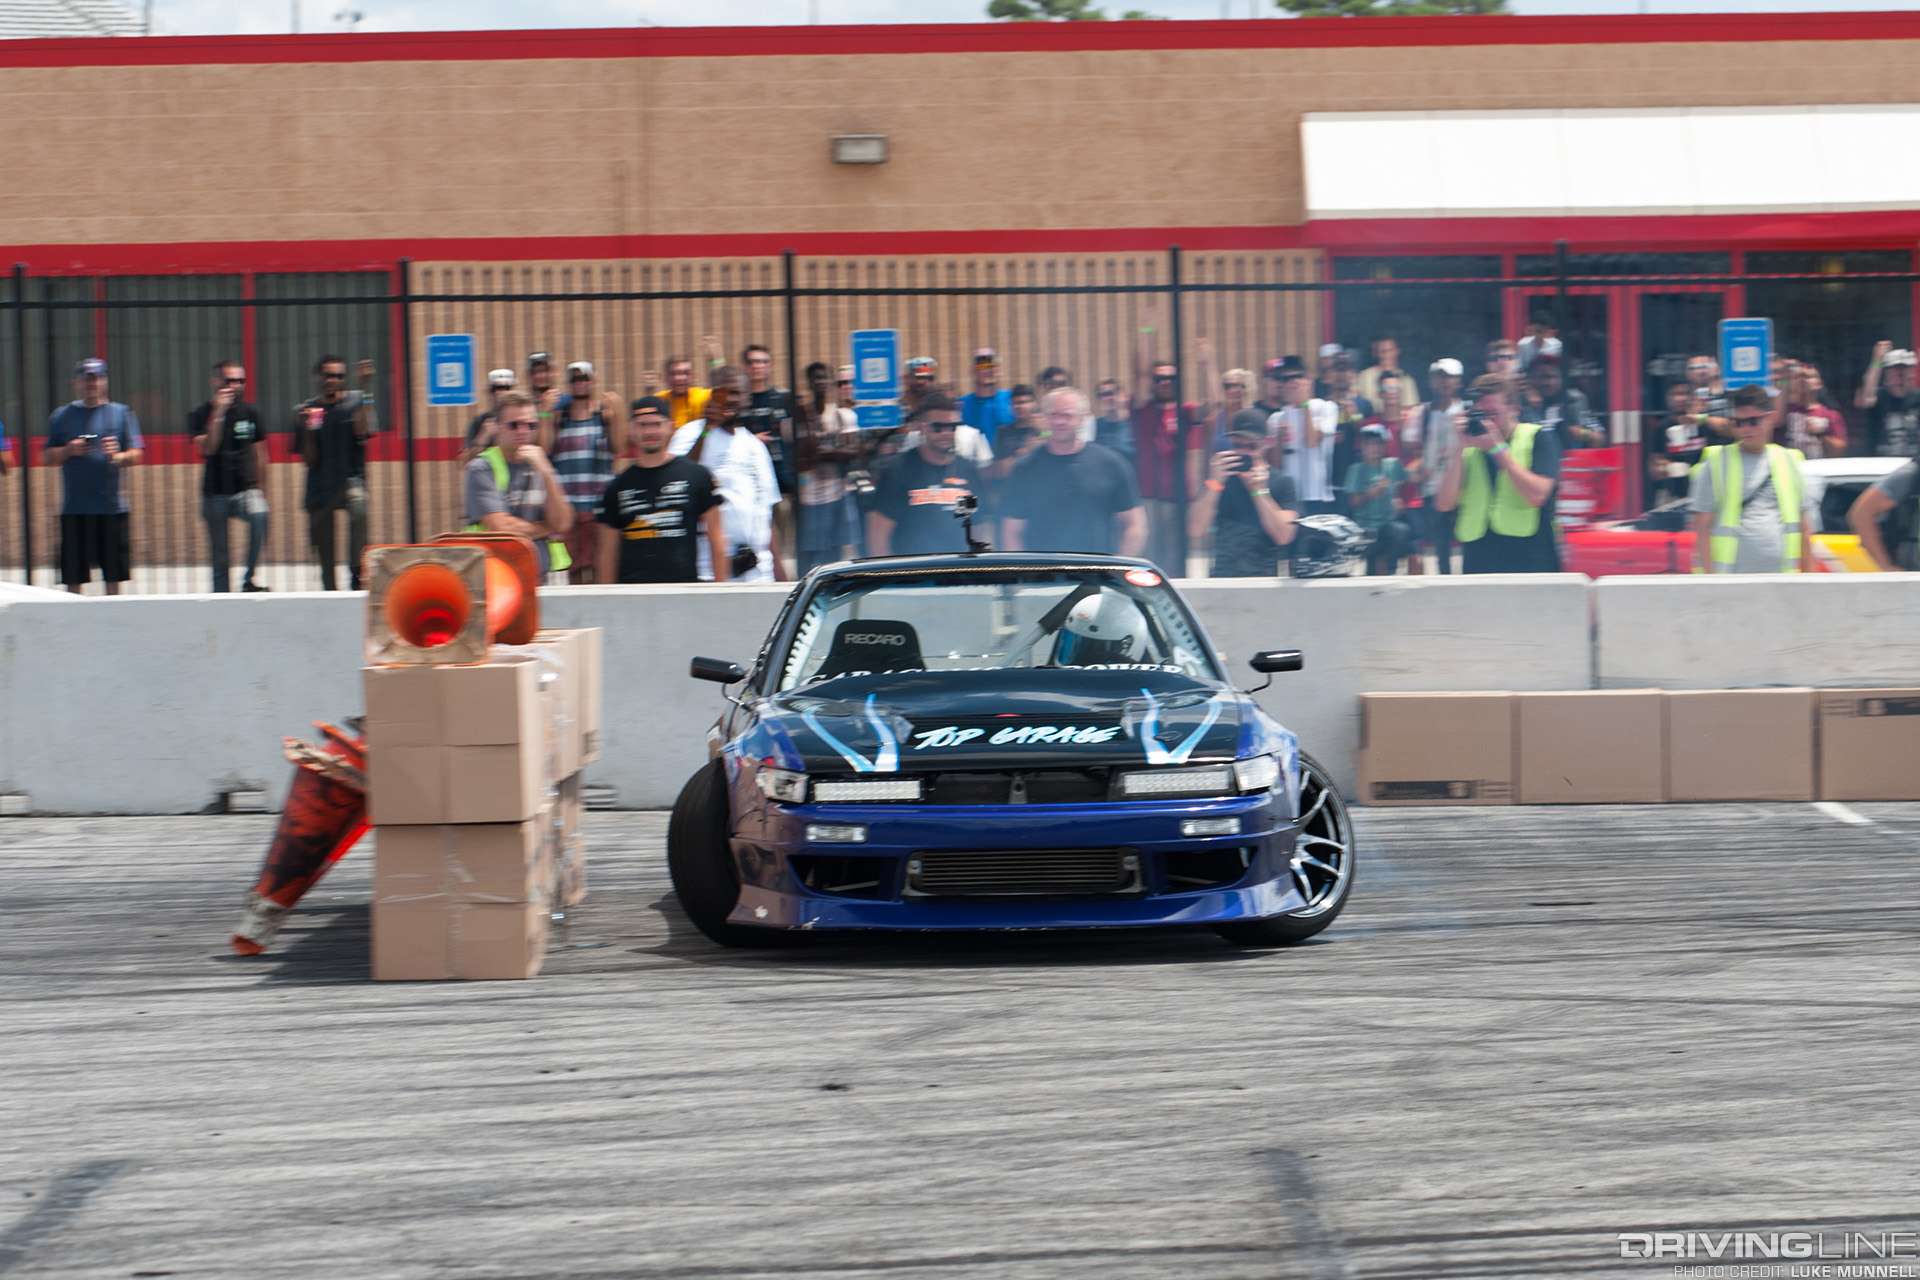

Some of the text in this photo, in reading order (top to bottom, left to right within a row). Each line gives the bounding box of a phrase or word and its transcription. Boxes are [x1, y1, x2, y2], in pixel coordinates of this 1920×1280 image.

[844, 633, 905, 646] RECARO
[914, 726, 1122, 750] TOP GARAGE
